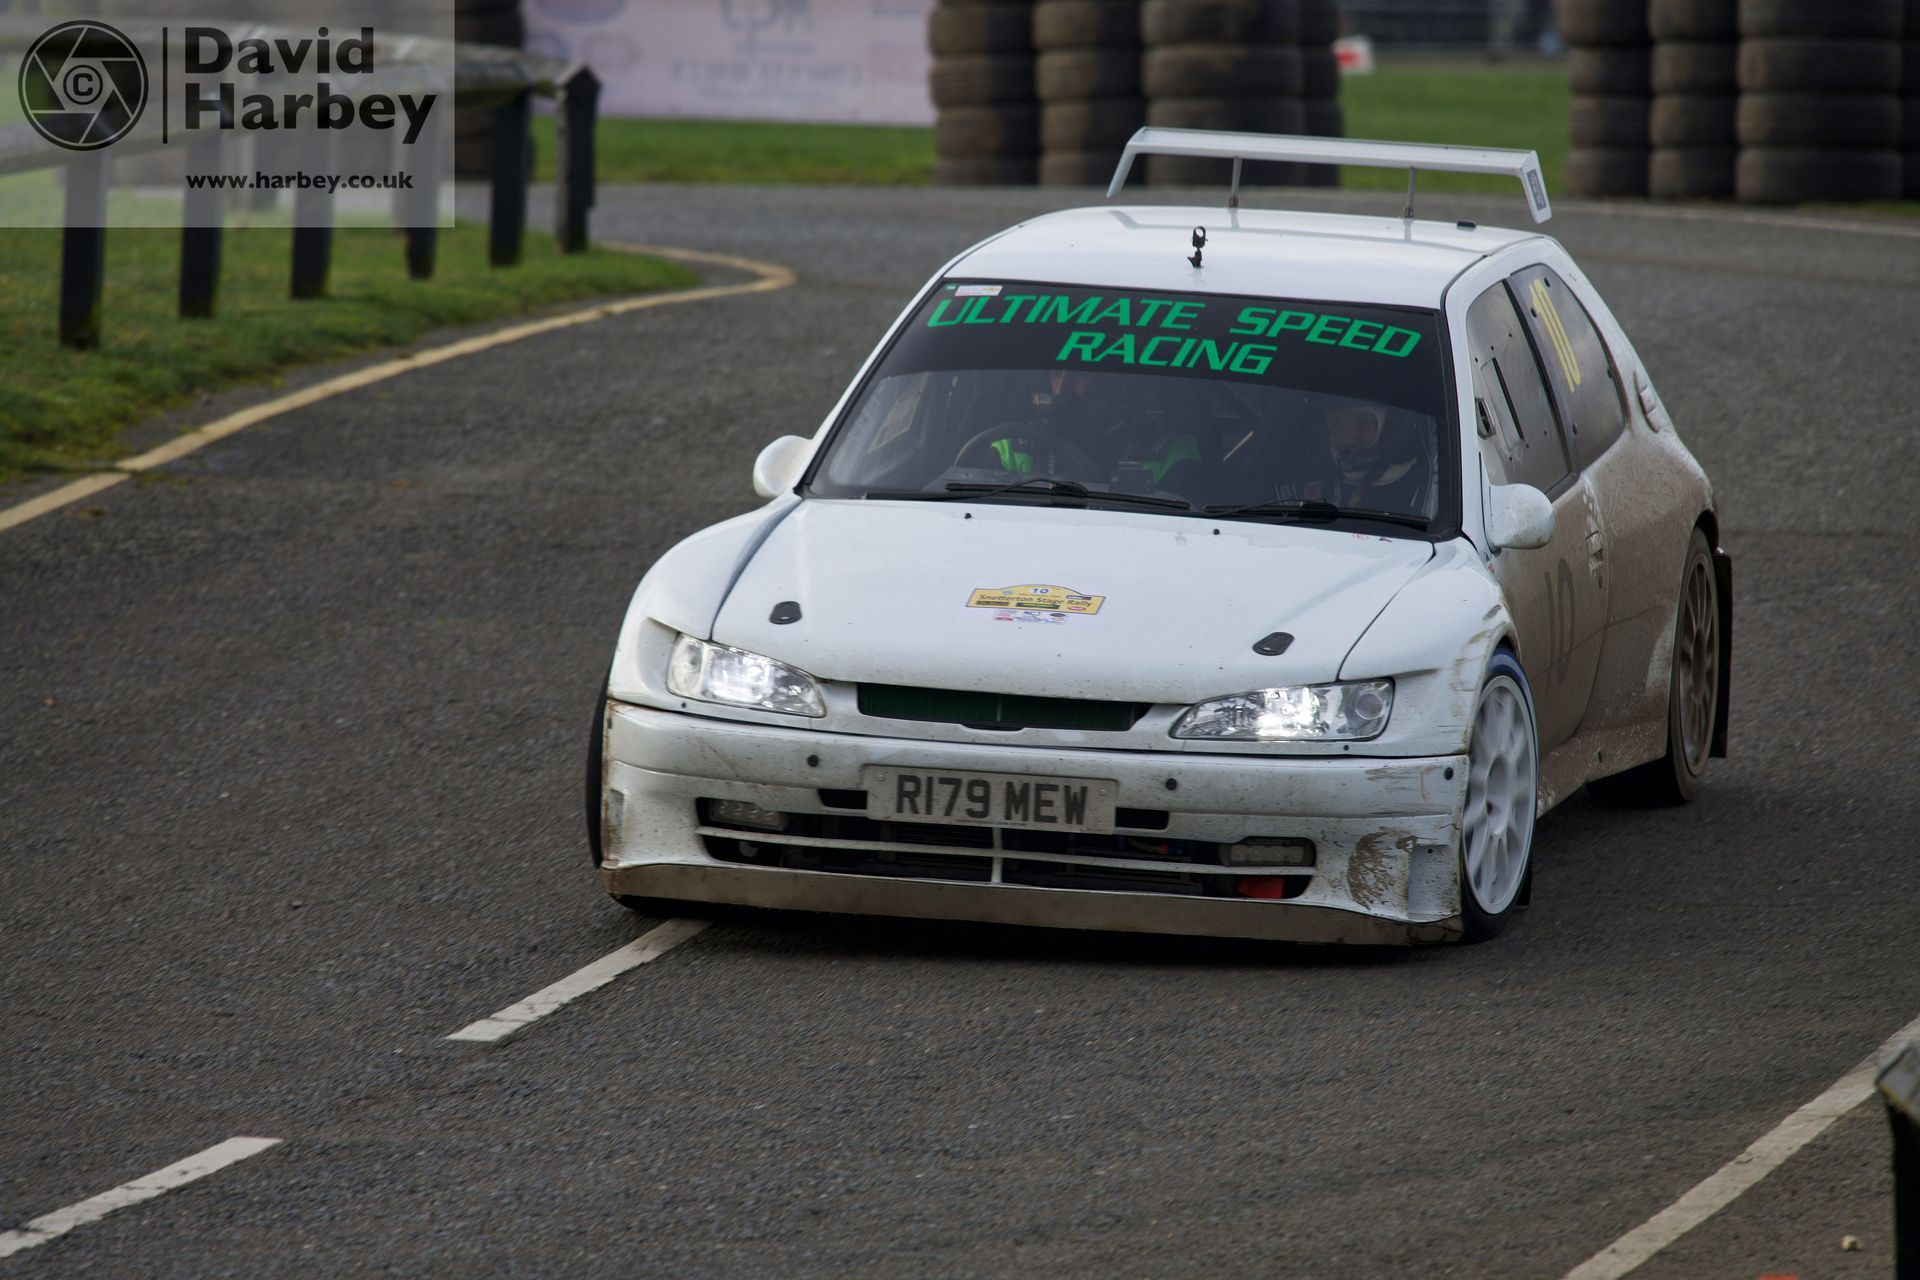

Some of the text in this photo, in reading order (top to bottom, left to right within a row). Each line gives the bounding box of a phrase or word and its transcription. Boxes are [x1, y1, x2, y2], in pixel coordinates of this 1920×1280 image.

[927, 294, 1422, 358] ULTIMATE SPEED
[1056, 331, 1278, 375] RACING
[1530, 278, 1581, 392] 10
[979, 594, 1034, 603] Snetterton
[1069, 599, 1093, 607] Rally
[1545, 558, 1576, 692] 10
[897, 775, 1088, 824] R179 MEW
